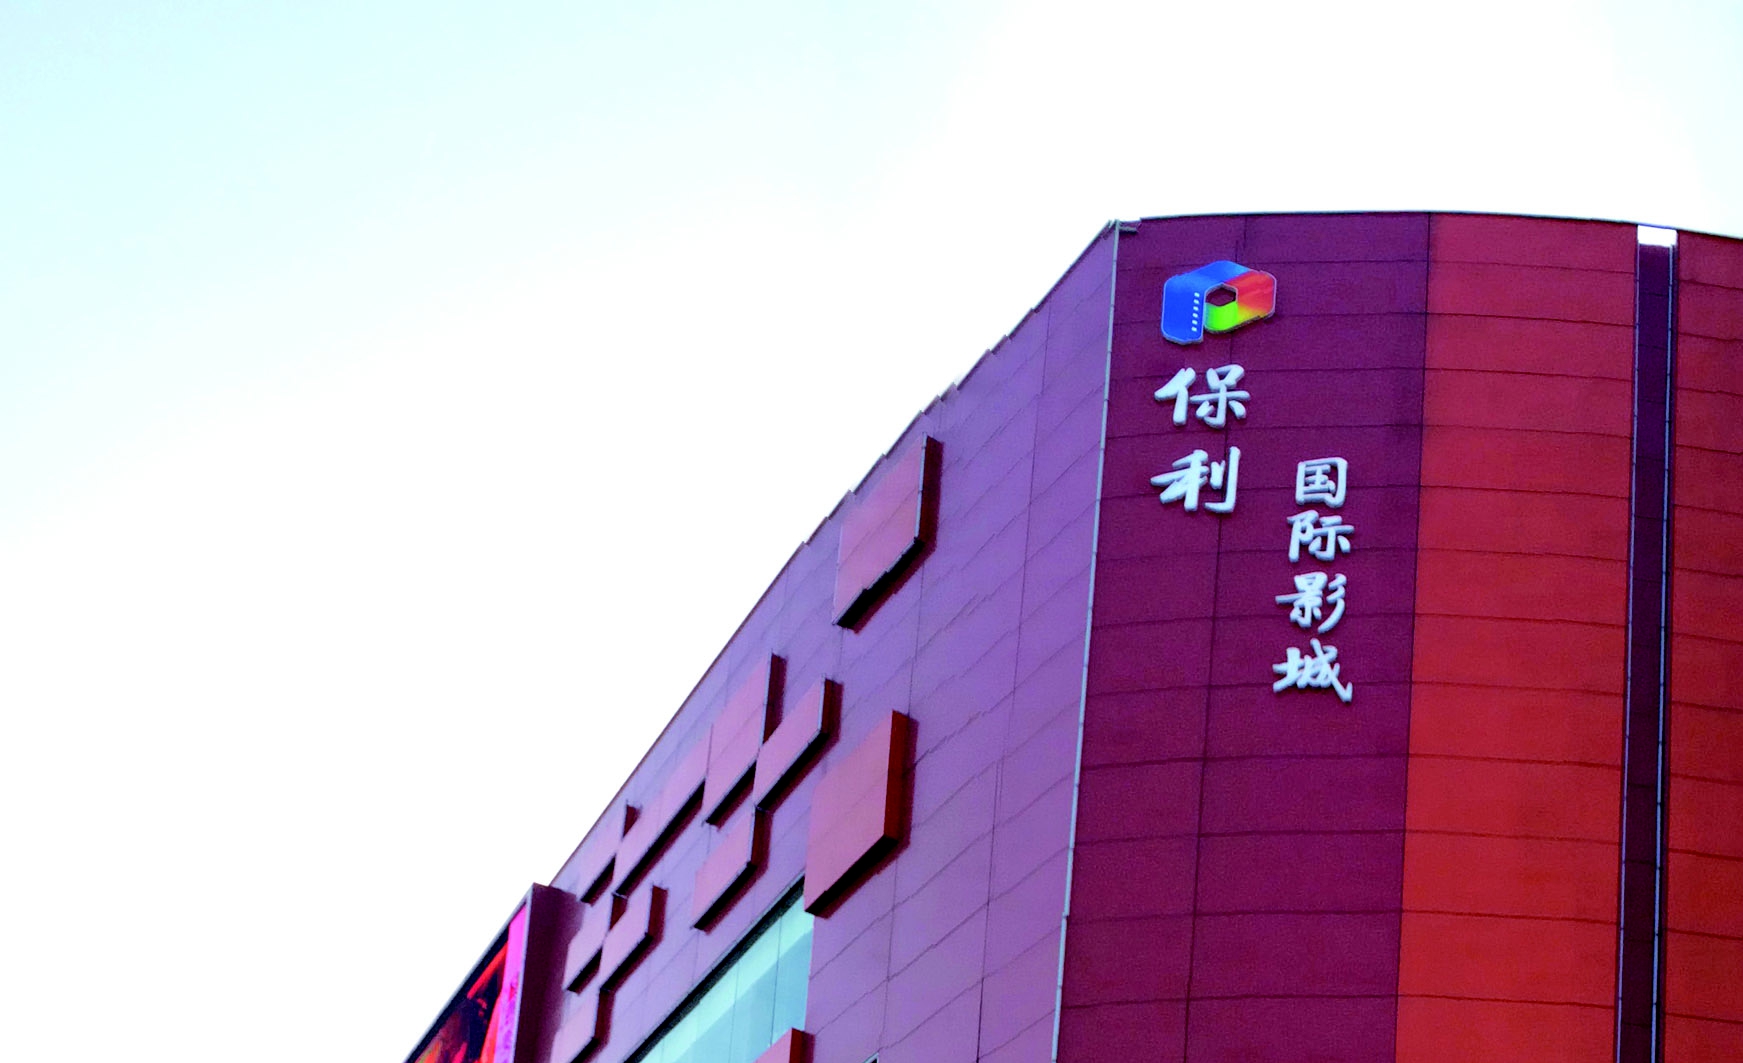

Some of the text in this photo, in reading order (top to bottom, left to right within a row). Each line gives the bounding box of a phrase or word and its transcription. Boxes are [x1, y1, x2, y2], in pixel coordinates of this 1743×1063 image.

[1150, 363, 1250, 513] 保利
[1273, 456, 1354, 703] 国际影城
